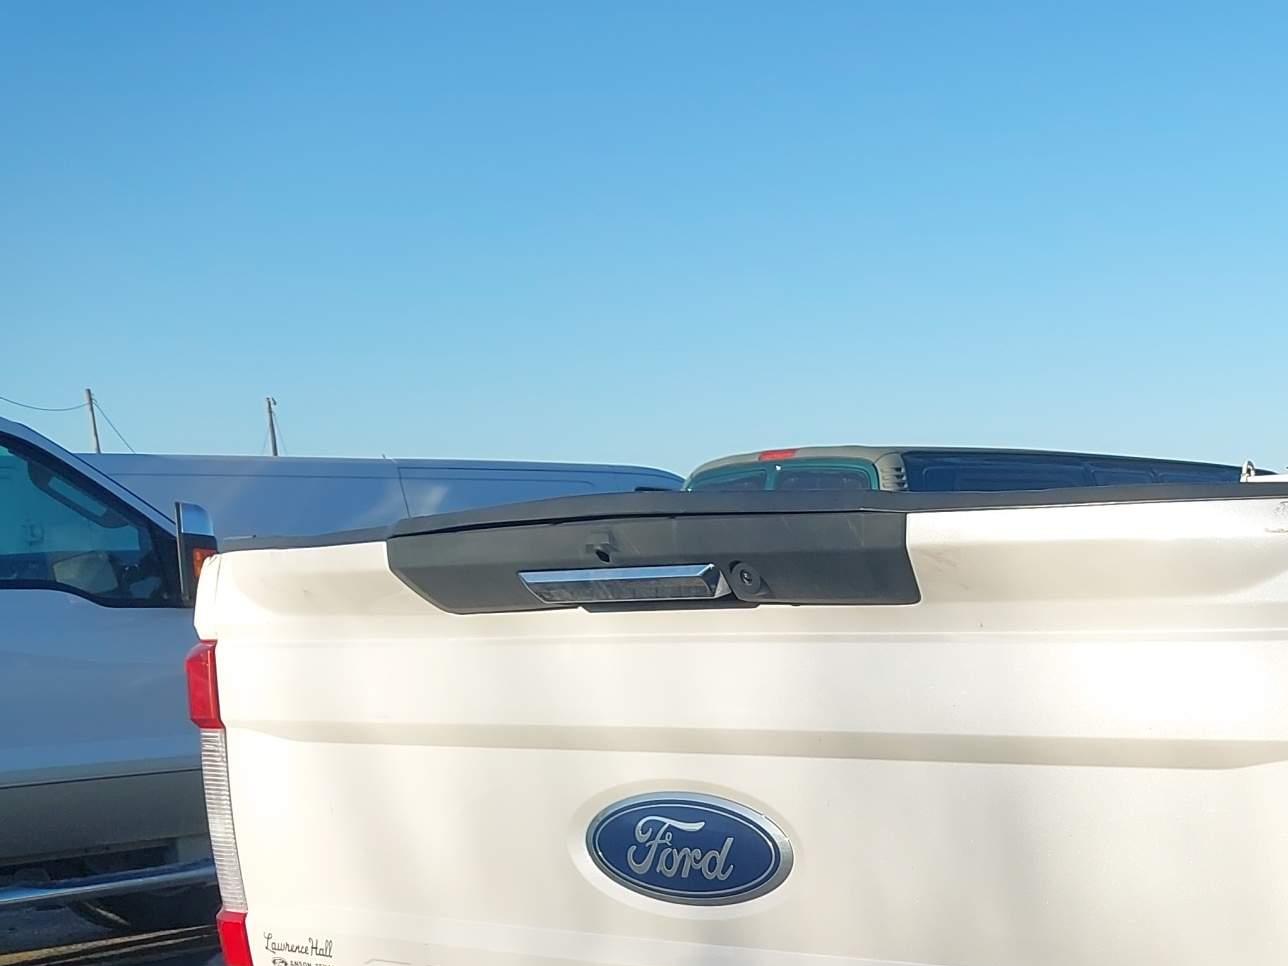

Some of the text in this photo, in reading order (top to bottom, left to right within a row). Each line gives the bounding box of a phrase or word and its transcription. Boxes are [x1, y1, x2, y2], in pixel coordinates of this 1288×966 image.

[626, 815, 736, 881] Ford
[263, 931, 333, 958] Lawrence Hall
